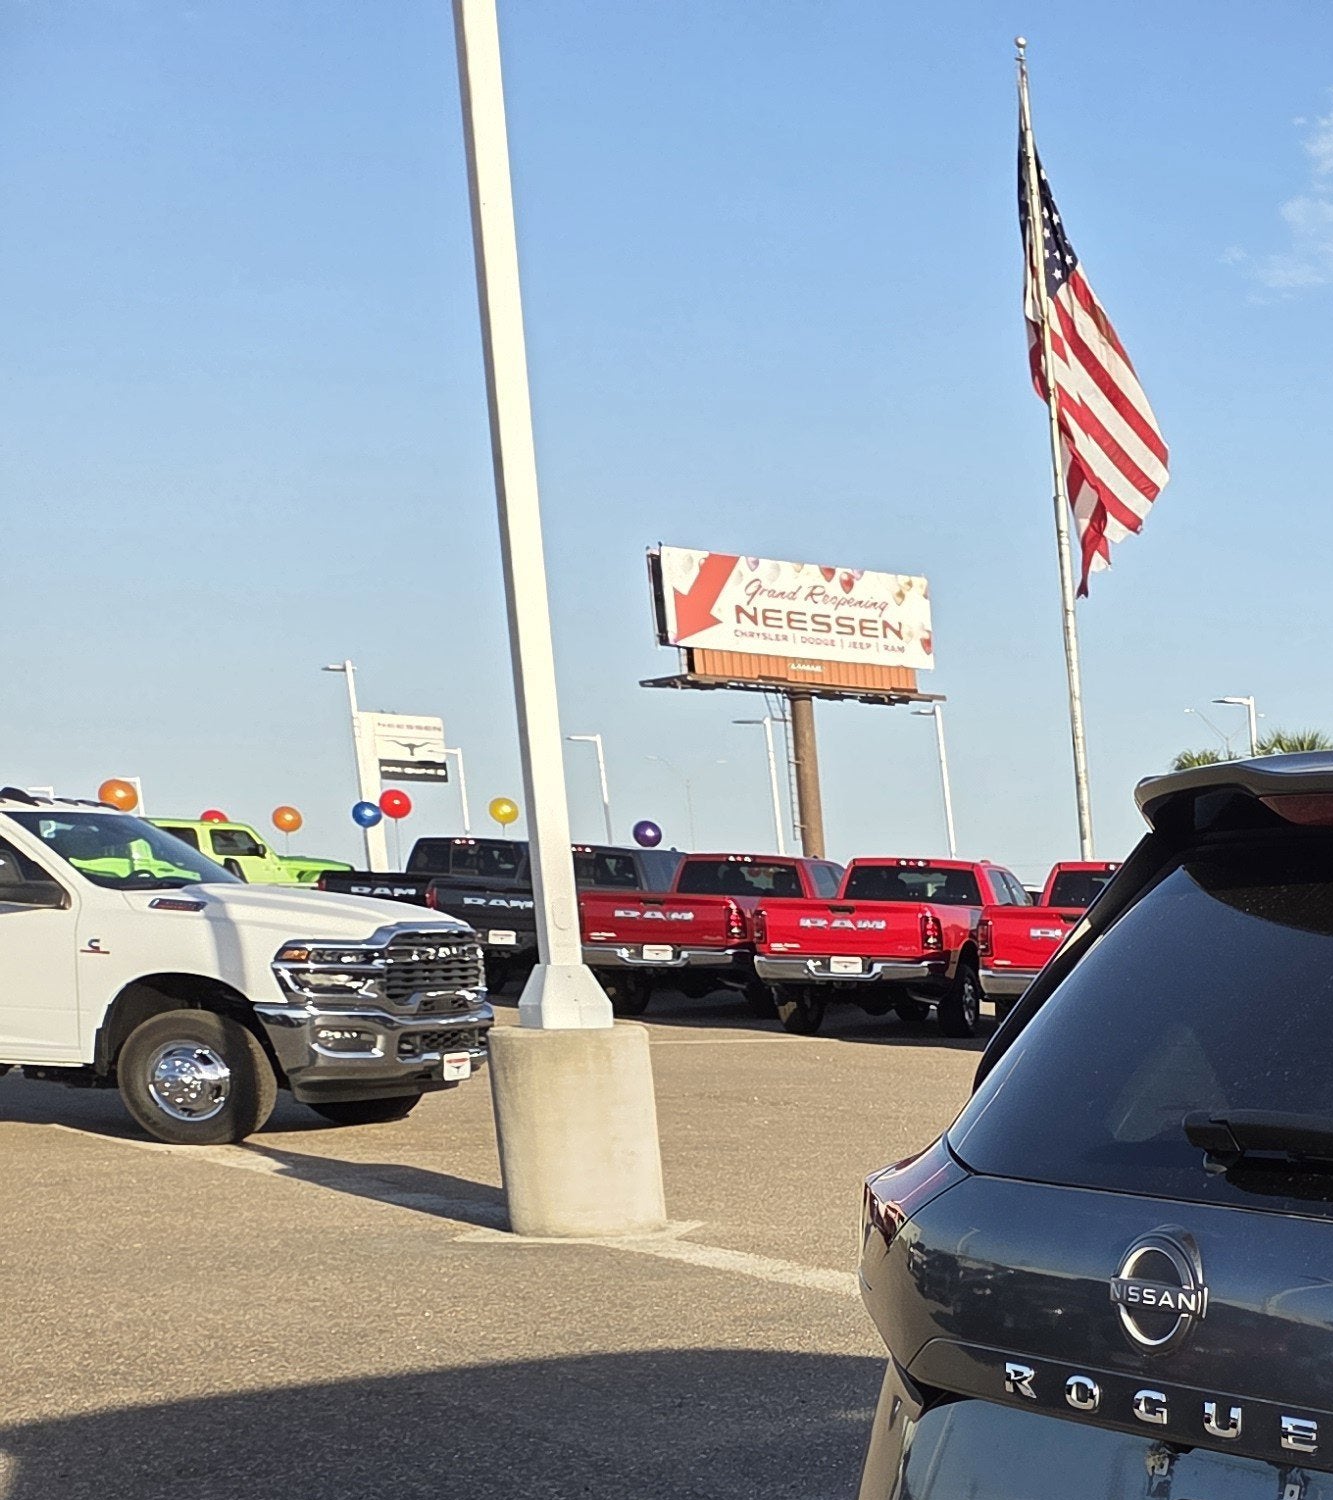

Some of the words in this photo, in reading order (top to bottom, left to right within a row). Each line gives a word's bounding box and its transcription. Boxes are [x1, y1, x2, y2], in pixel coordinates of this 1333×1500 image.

[744, 578, 802, 606] Grand
[804, 585, 888, 617] Reopening
[735, 604, 904, 641] NEESSEN
[733, 629, 789, 642] CHRYSLER
[800, 636, 836, 648] DODGE
[848, 641, 872, 651] JEEP
[883, 644, 906, 654] RAM
[350, 885, 417, 897] RAM
[463, 896, 534, 910] RAM
[613, 908, 695, 921] RAM
[799, 916, 887, 931] RAM
[1110, 1281, 1198, 1313] NISSAN
[1004, 1361, 1320, 1454] ROGUE
